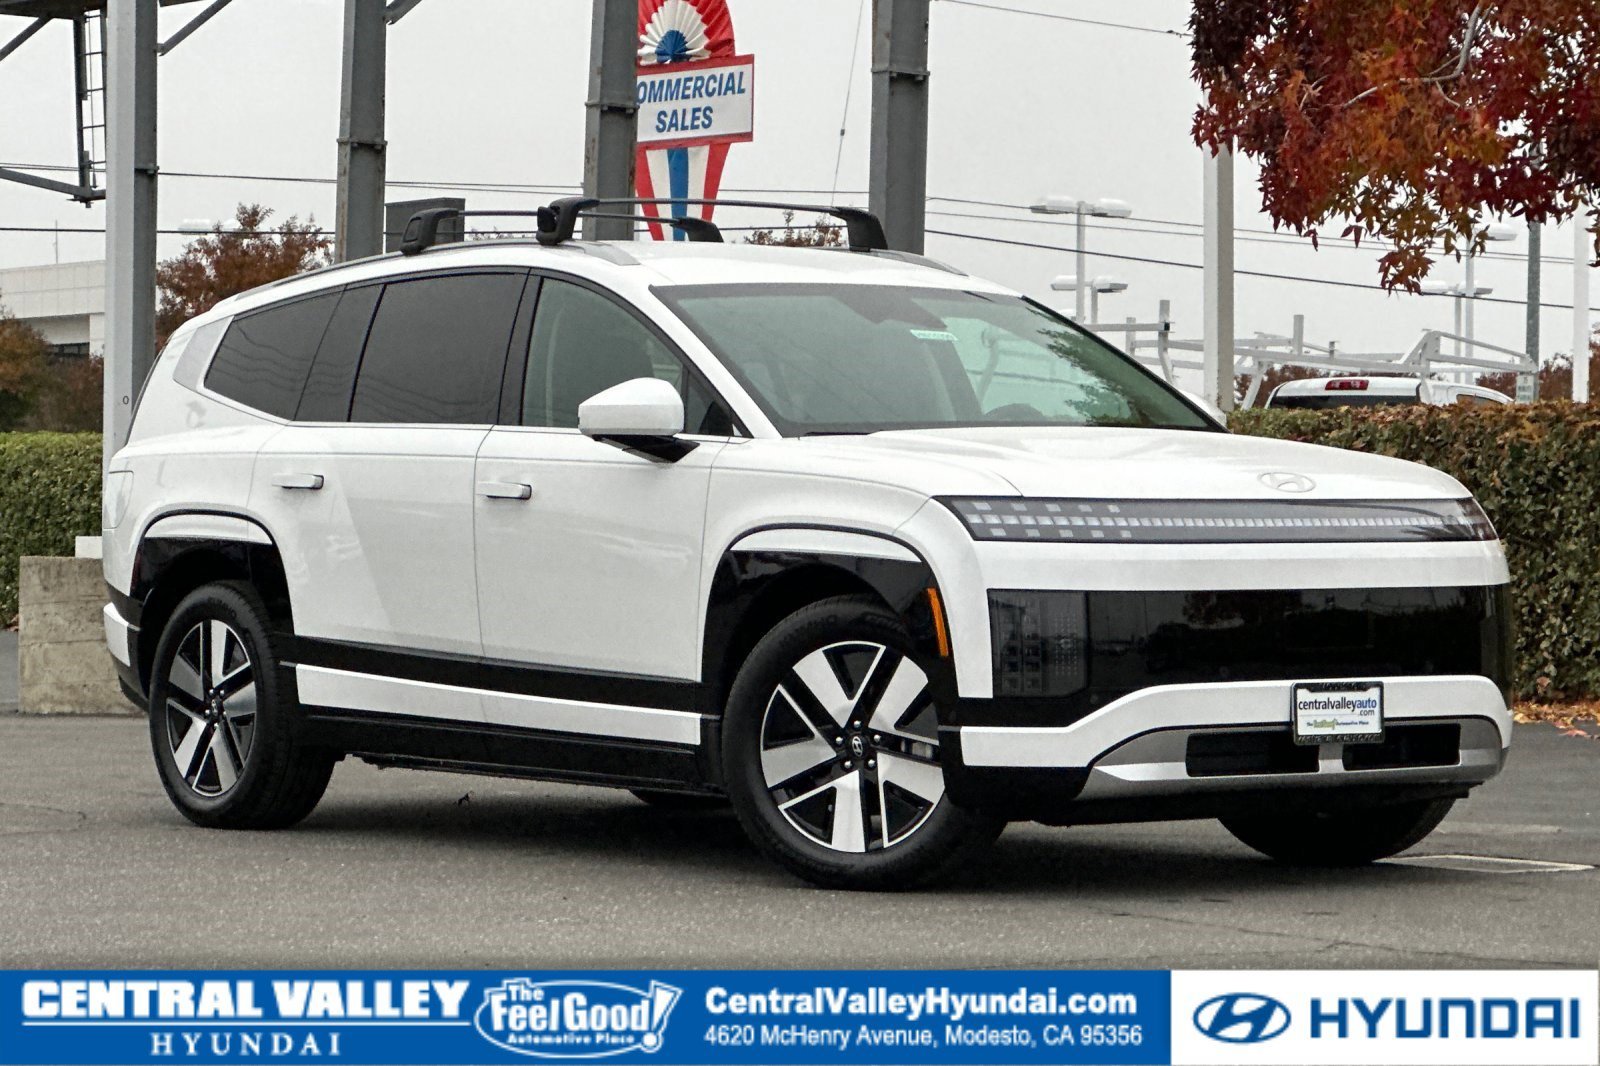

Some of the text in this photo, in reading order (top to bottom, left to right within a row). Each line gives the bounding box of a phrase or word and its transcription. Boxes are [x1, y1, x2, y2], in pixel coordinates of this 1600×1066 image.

[636, 71, 746, 105] OMMERCIAL
[655, 106, 714, 133] SALES
[1298, 696, 1377, 712] centralvalleyauto
